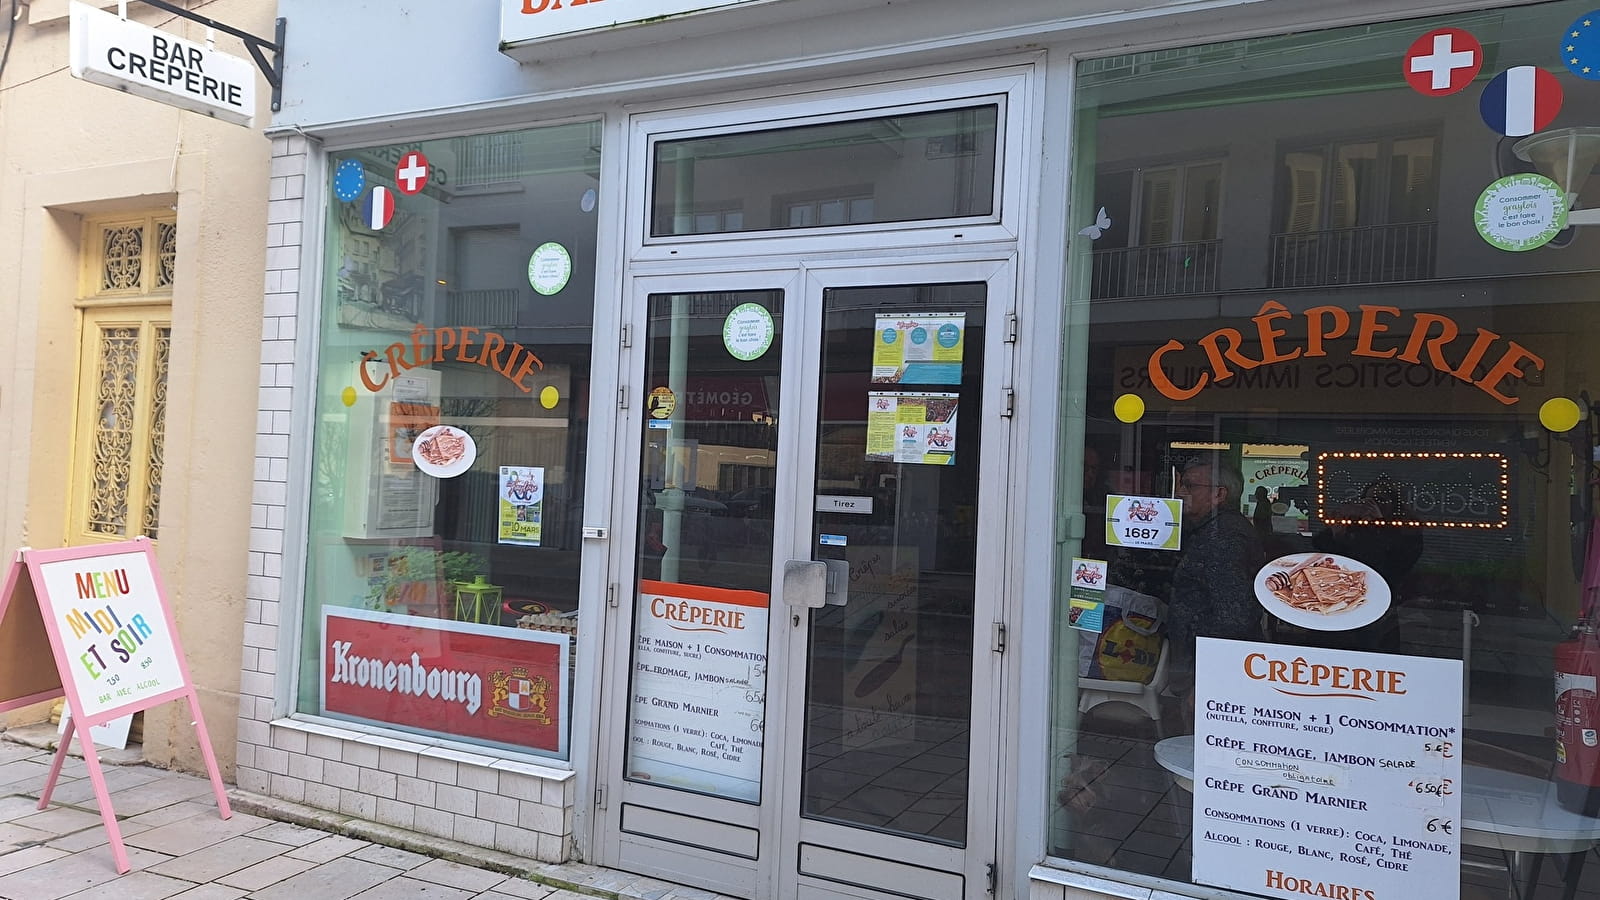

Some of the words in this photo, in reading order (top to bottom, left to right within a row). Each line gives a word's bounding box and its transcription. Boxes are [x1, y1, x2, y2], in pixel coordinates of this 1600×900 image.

[153, 35, 203, 73] BAR
[107, 47, 242, 107] CREPERIE
[1499, 194, 1541, 203] Consommer
[360, 323, 544, 393] CRÊPERIE
[1148, 300, 1544, 404] CRÊPERIE
[834, 500, 855, 508] Tirez
[1326, 470, 1498, 515] Crêperie
[1125, 527, 1159, 539] 1687
[75, 569, 130, 599] MENU
[66, 605, 122, 640] MIDI
[650, 598, 745, 630] CRÊPERIE
[80, 644, 106, 680] ET
[111, 613, 152, 663] SOIR
[655, 638, 683, 650] MAISON
[137, 679, 160, 690] ALCOOL
[331, 640, 482, 715] Kronenbourg
[694, 672, 725, 684] JAMBON
[1244, 653, 1407, 695] CRÊPERIE
[652, 697, 679, 710] GRAND
[682, 702, 719, 717] MARNIER
[1206, 700, 1246, 715] CRÊPE
[1254, 706, 1301, 721] MAISON
[1309, 714, 1317, 722] +
[1325, 714, 1330, 725] 1
[1206, 711, 1248, 725] (NUTELLA,
[1252, 718, 1299, 731] CONFITURE,
[1303, 724, 1334, 736] SUCRE)
[652, 738, 674, 750] ROUGE,
[677, 743, 698, 755] BLANC,
[1206, 735, 1245, 750] CRÊPE
[1324, 752, 1375, 767] JAMBON
[1379, 759, 1416, 768] SALADE
[1205, 777, 1245, 793] CRÊPE
[1252, 784, 1298, 801] GRAND
[1306, 791, 1367, 811] MARNIER
[1204, 808, 1285, 828] CONSOMMATIONS
[1355, 830, 1387, 845] COCA,
[1393, 836, 1452, 855] LIMONADE,
[1204, 831, 1242, 845] ALCOOL
[1255, 839, 1292, 854] ROUGE,
[1298, 845, 1334, 861] BLANC,
[1340, 852, 1371, 867] ROSÉ,
[1376, 858, 1409, 872] CIDRE
[1355, 843, 1385, 857] CAFÉ,
[1391, 848, 1412, 860] THÉ
